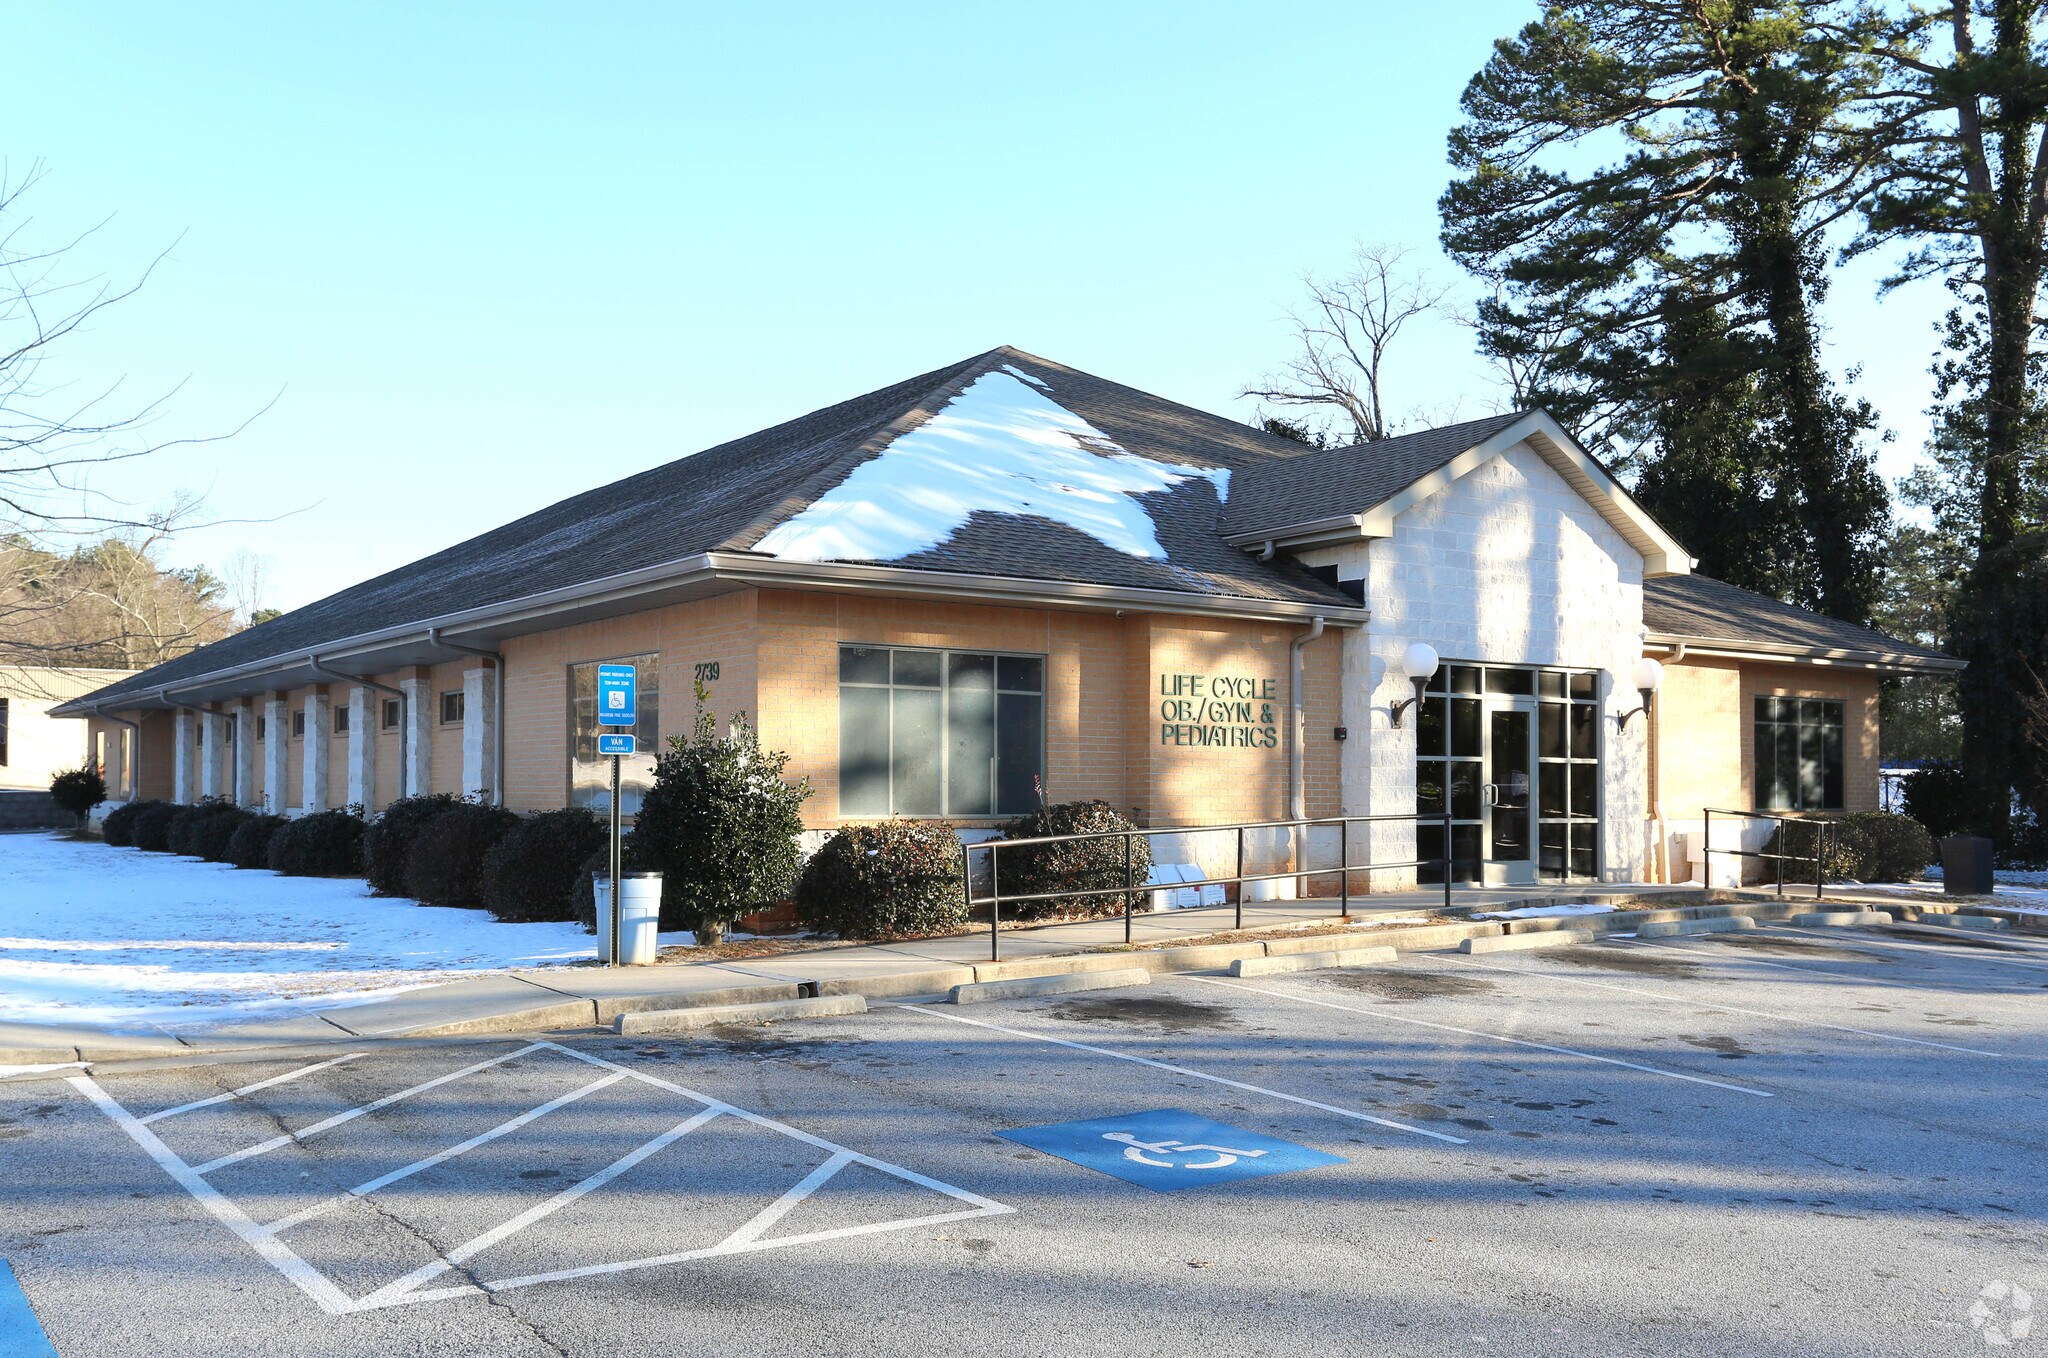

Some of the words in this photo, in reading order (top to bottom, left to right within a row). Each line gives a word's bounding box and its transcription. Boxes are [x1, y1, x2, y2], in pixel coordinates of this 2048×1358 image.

[695, 662, 719, 681] 2739
[1161, 674, 1205, 697] LIFE
[1212, 676, 1276, 700] CYCLE
[1261, 703, 1274, 723] &
[1161, 723, 1278, 749] PEDIATRICS
